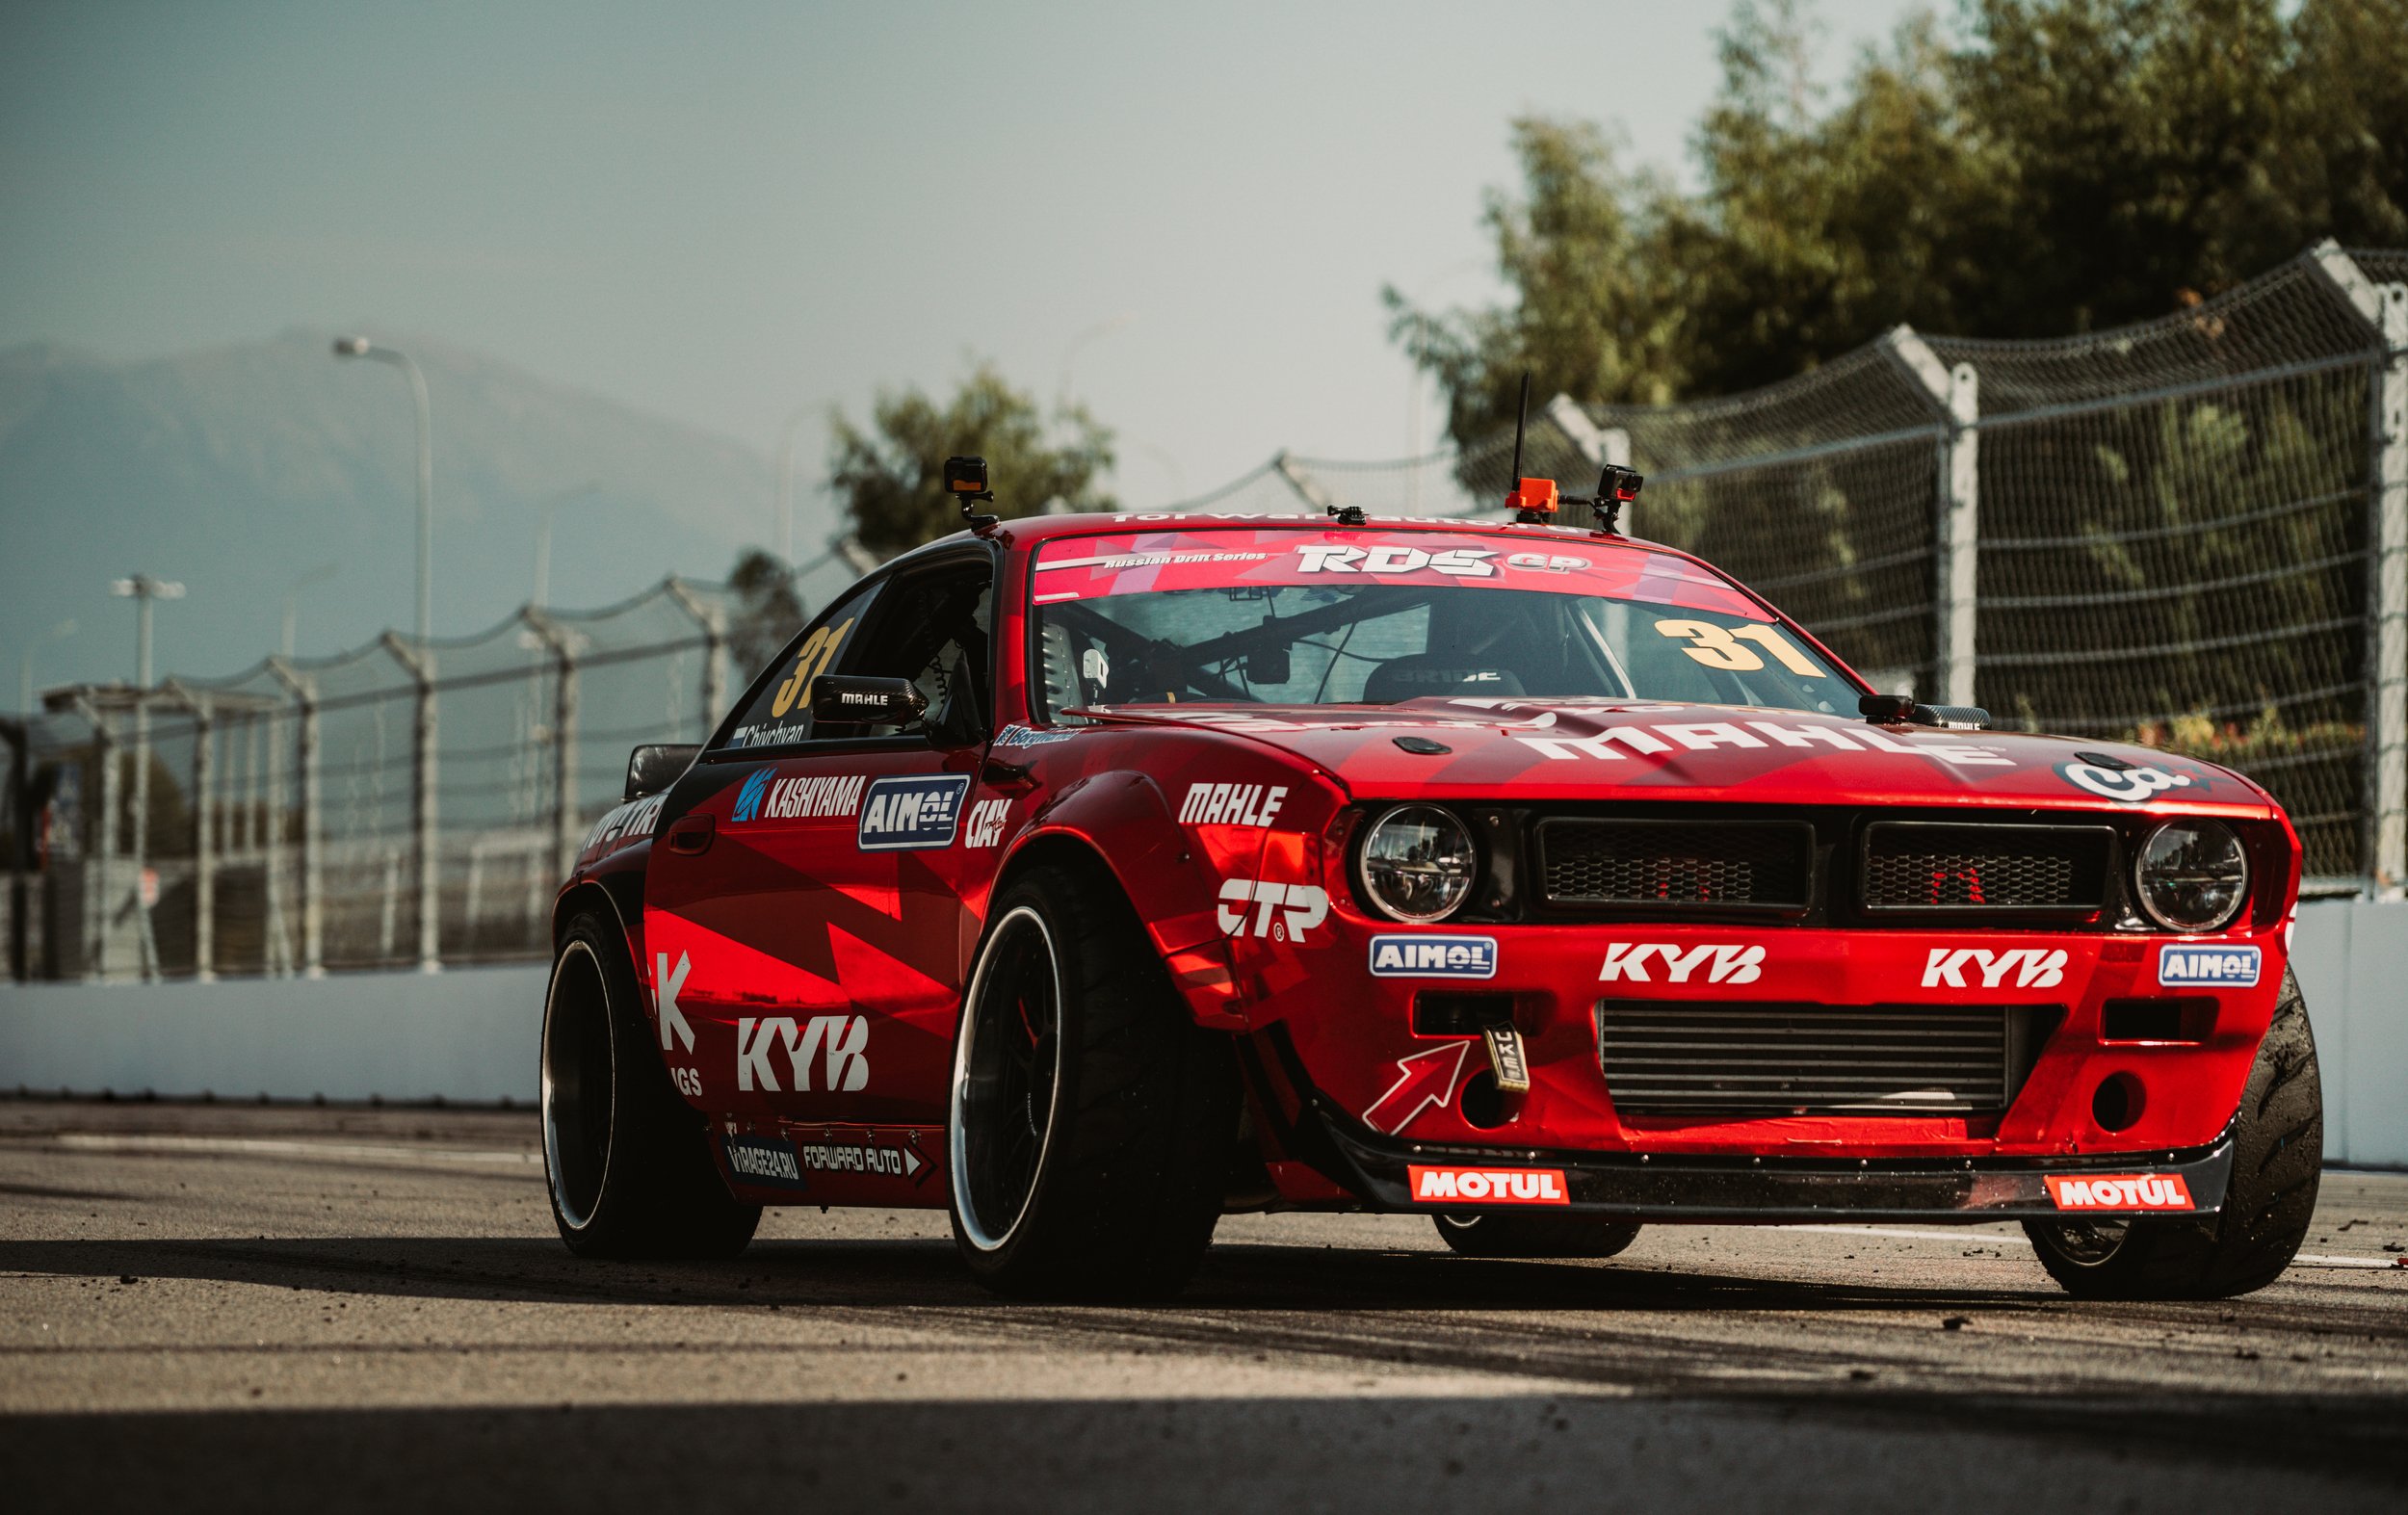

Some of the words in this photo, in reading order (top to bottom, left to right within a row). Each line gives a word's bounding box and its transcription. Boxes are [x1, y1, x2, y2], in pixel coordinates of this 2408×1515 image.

[1104, 557, 1172, 568] Russian
[1173, 553, 1212, 563] Drift
[1213, 552, 1269, 562] Series
[1296, 545, 1499, 576] RDS
[1504, 552, 1590, 572] GP
[772, 617, 855, 718] 31
[1654, 619, 1827, 678] 31
[841, 692, 888, 706] MAHLE
[1513, 721, 2017, 766] MAHLE
[765, 775, 867, 819] KASHIYAMA
[863, 790, 955, 833] AIMOL
[1178, 783, 1289, 827] MAHLE
[1375, 945, 1491, 970] AIMOL
[1598, 942, 1767, 984] KYB
[1921, 949, 2069, 988] KYB
[2163, 954, 2257, 980] AIMOL
[738, 1015, 869, 1091] KYB
[803, 1145, 864, 1171] FORWARD
[866, 1148, 902, 1175] AUTO
[1419, 1171, 1561, 1199] MOTUL
[2059, 1180, 2186, 1206] MOTUL
